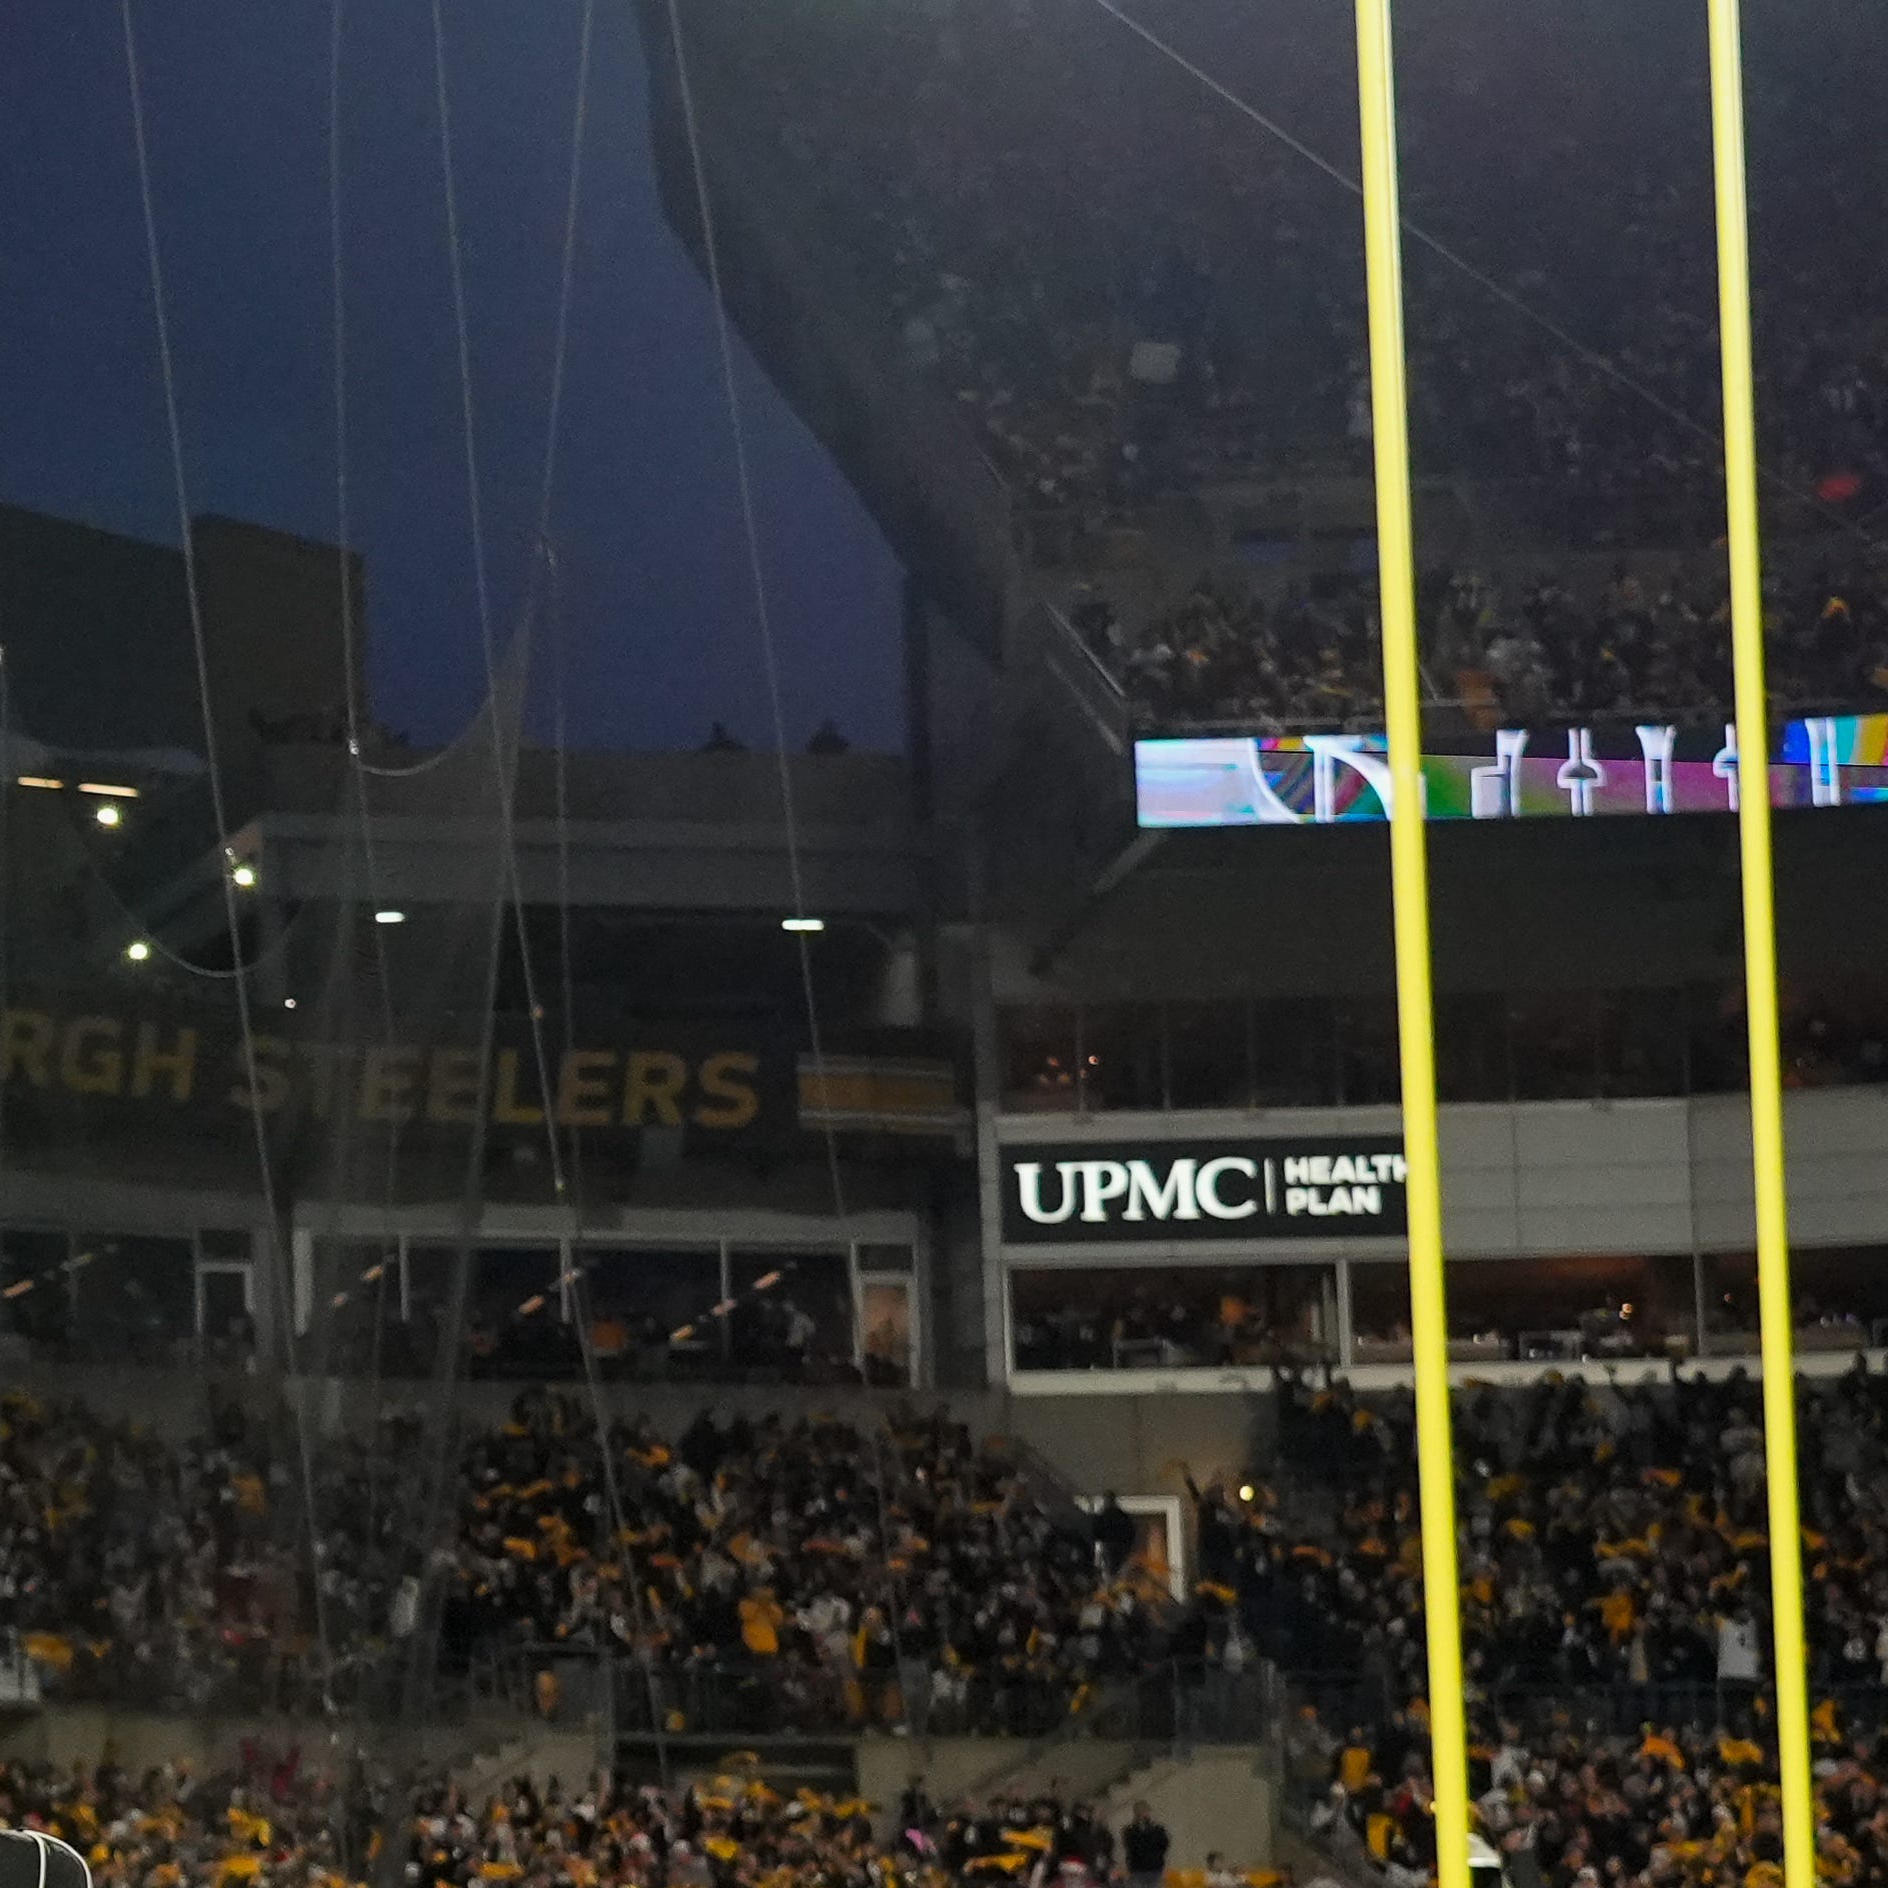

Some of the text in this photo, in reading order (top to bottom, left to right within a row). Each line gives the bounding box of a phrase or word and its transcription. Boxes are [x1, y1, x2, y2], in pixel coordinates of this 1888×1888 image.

[229, 1030, 761, 1128] STEELERS
[1014, 1157, 1258, 1223] UPMC
[1285, 1186, 1382, 1216] PLAN
